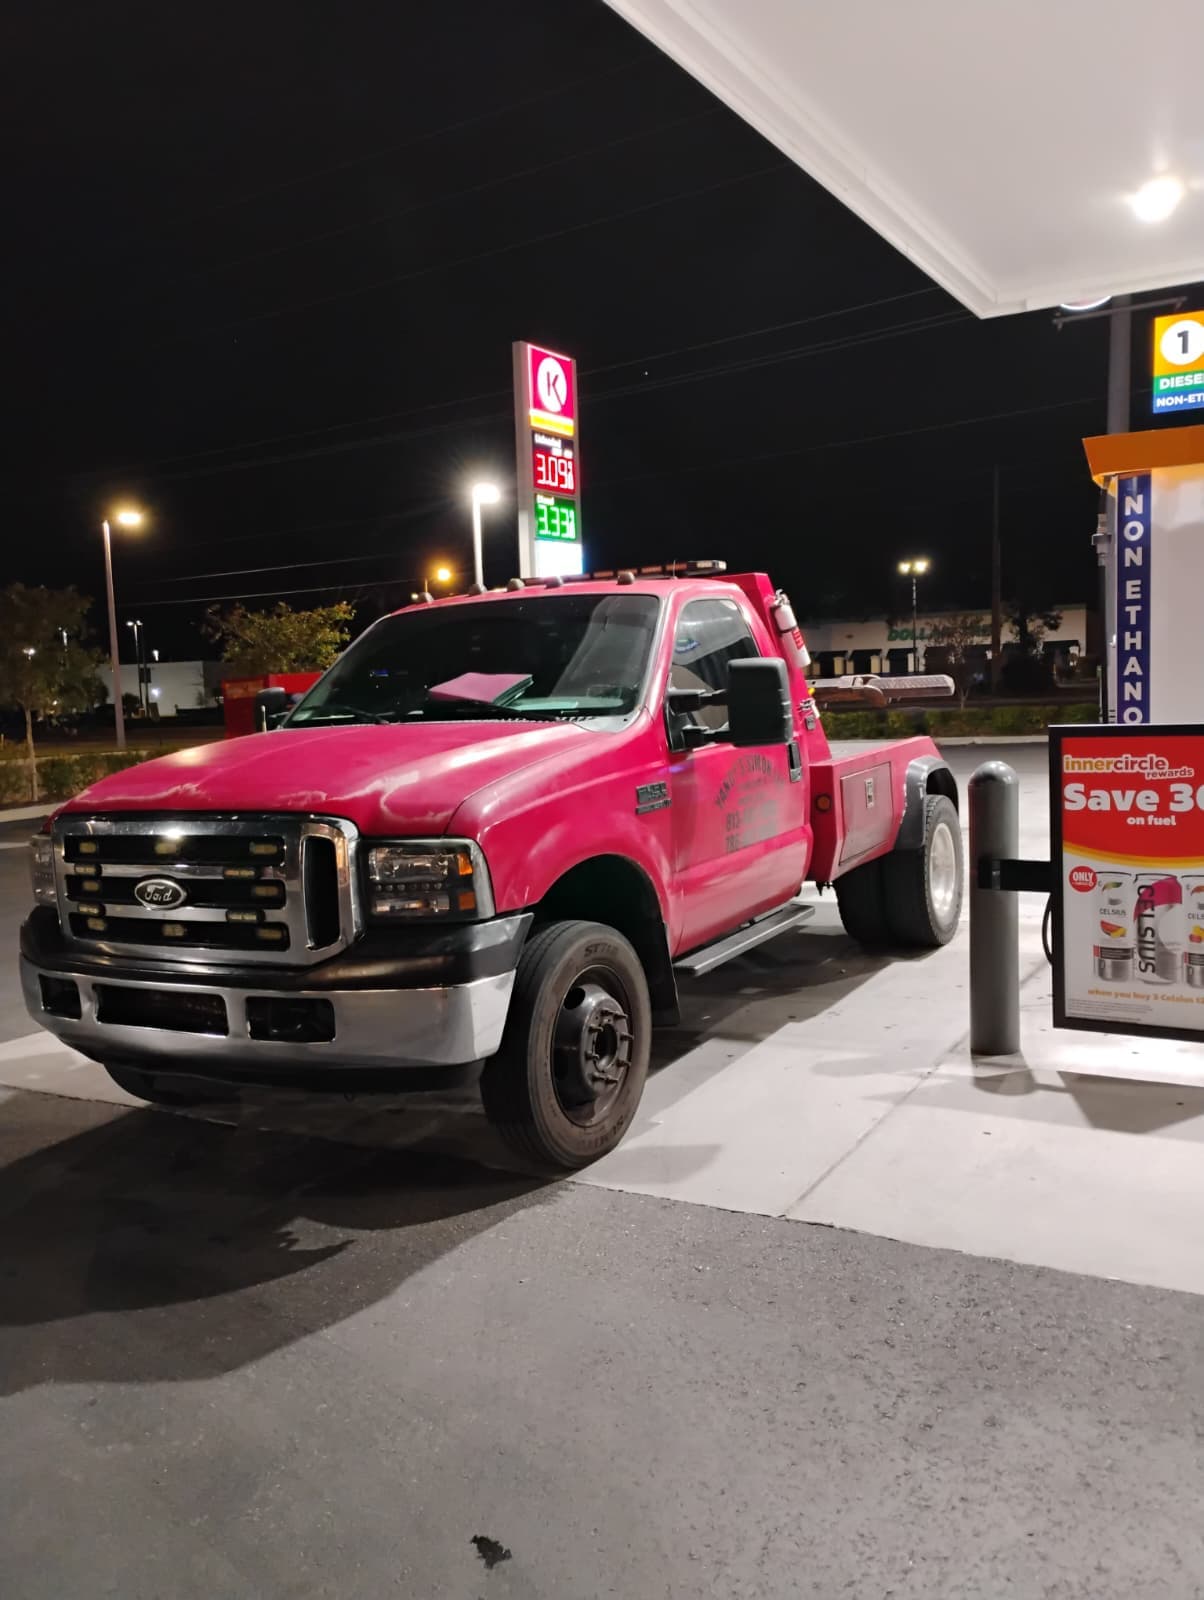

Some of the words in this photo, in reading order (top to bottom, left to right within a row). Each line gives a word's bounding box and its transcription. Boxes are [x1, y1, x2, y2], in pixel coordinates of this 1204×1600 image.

[1177, 330, 1189, 354] 1
[1124, 494, 1144, 567] NON
[1064, 755, 1168, 773] innercircle
[1146, 767, 1193, 779] rewards
[1064, 783, 1160, 811] Save
[1127, 817, 1145, 825] on
[1148, 815, 1177, 826] fuel
[1072, 871, 1094, 882] ONLY
[145, 885, 173, 902] Ford
[1100, 908, 1127, 917] CELSIUS
[1137, 885, 1156, 973] CELSIUS
